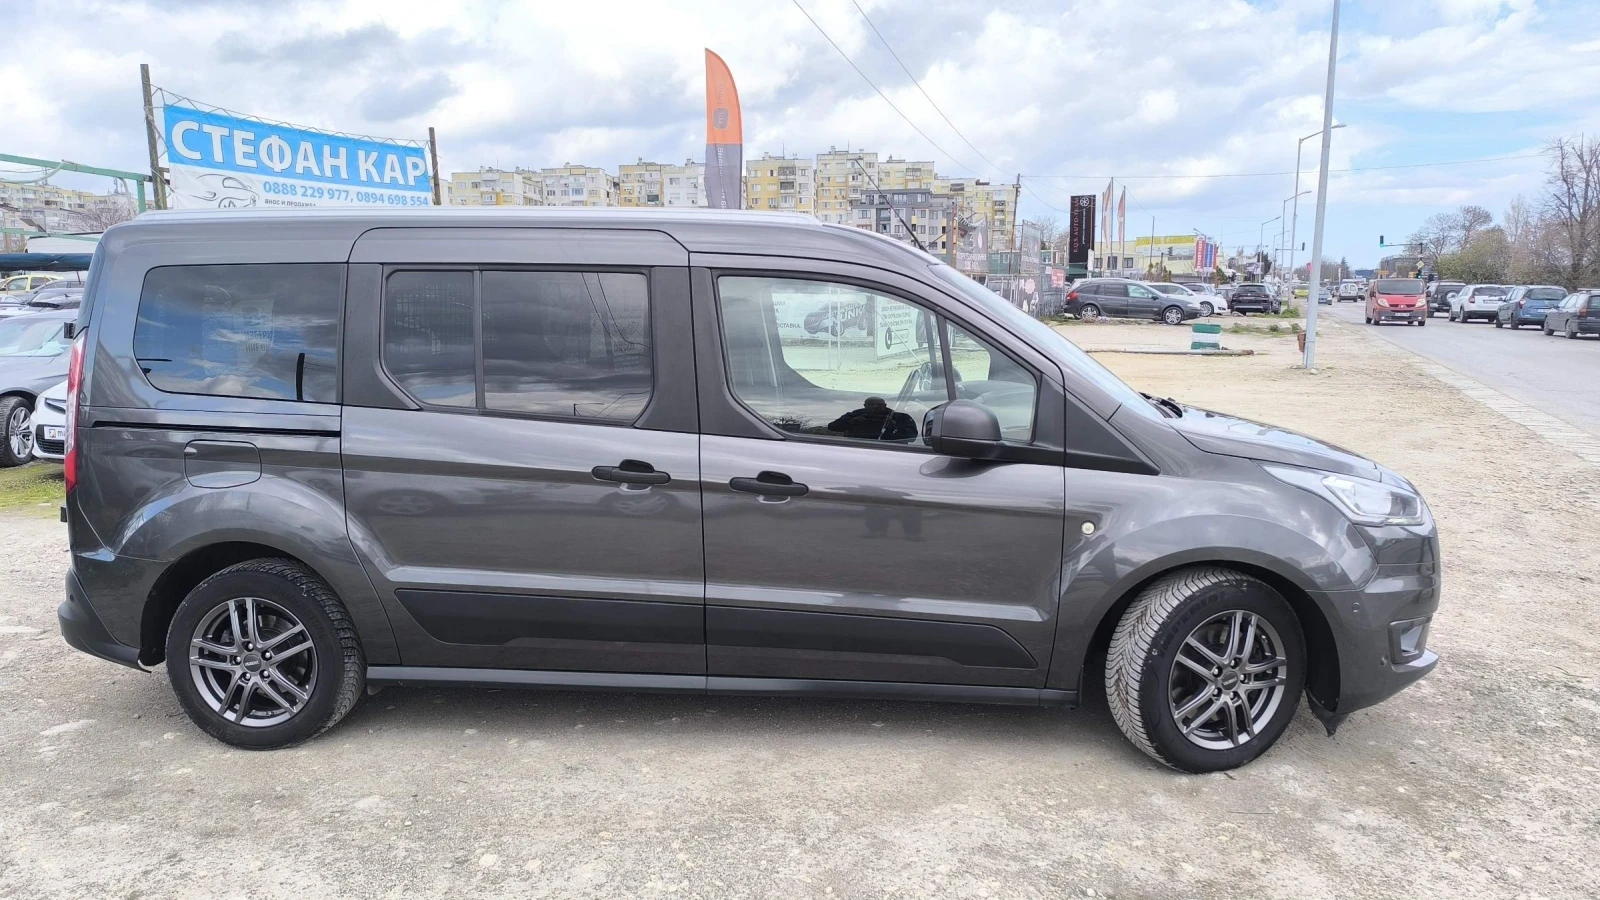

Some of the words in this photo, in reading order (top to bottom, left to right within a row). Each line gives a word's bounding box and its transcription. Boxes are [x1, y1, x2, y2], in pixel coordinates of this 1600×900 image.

[171, 120, 349, 180] СТЕФАН
[357, 149, 426, 187] КАР
[263, 181, 297, 196] 0888
[300, 185, 324, 199] 229
[327, 188, 353, 203] 977,
[356, 191, 385, 204] 0894
[387, 194, 408, 206] 698
[410, 196, 429, 206] 554
